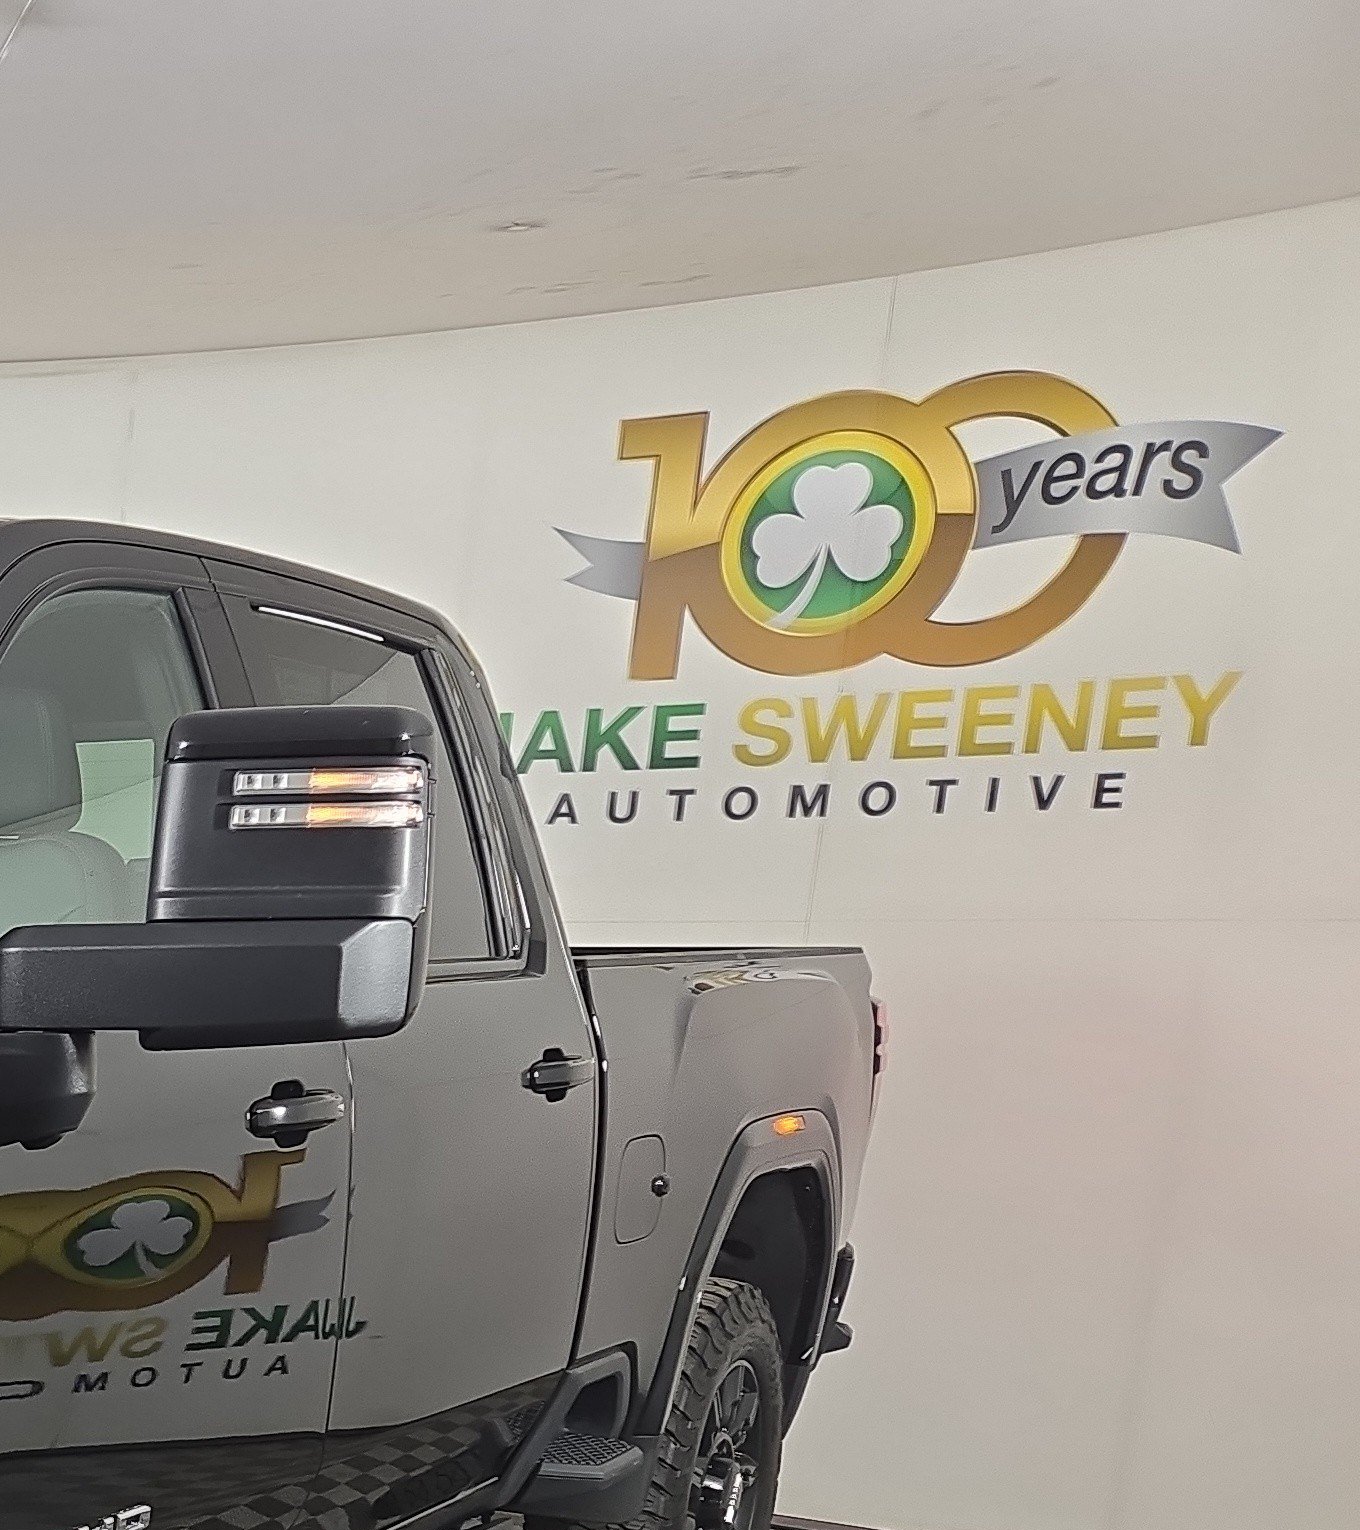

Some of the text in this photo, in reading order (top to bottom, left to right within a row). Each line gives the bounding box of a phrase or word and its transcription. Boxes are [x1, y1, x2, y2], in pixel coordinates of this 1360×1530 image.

[990, 434, 1210, 535] years
[731, 671, 1244, 767] SWEENEY
[544, 771, 1128, 827] AUTOMOTIVE
